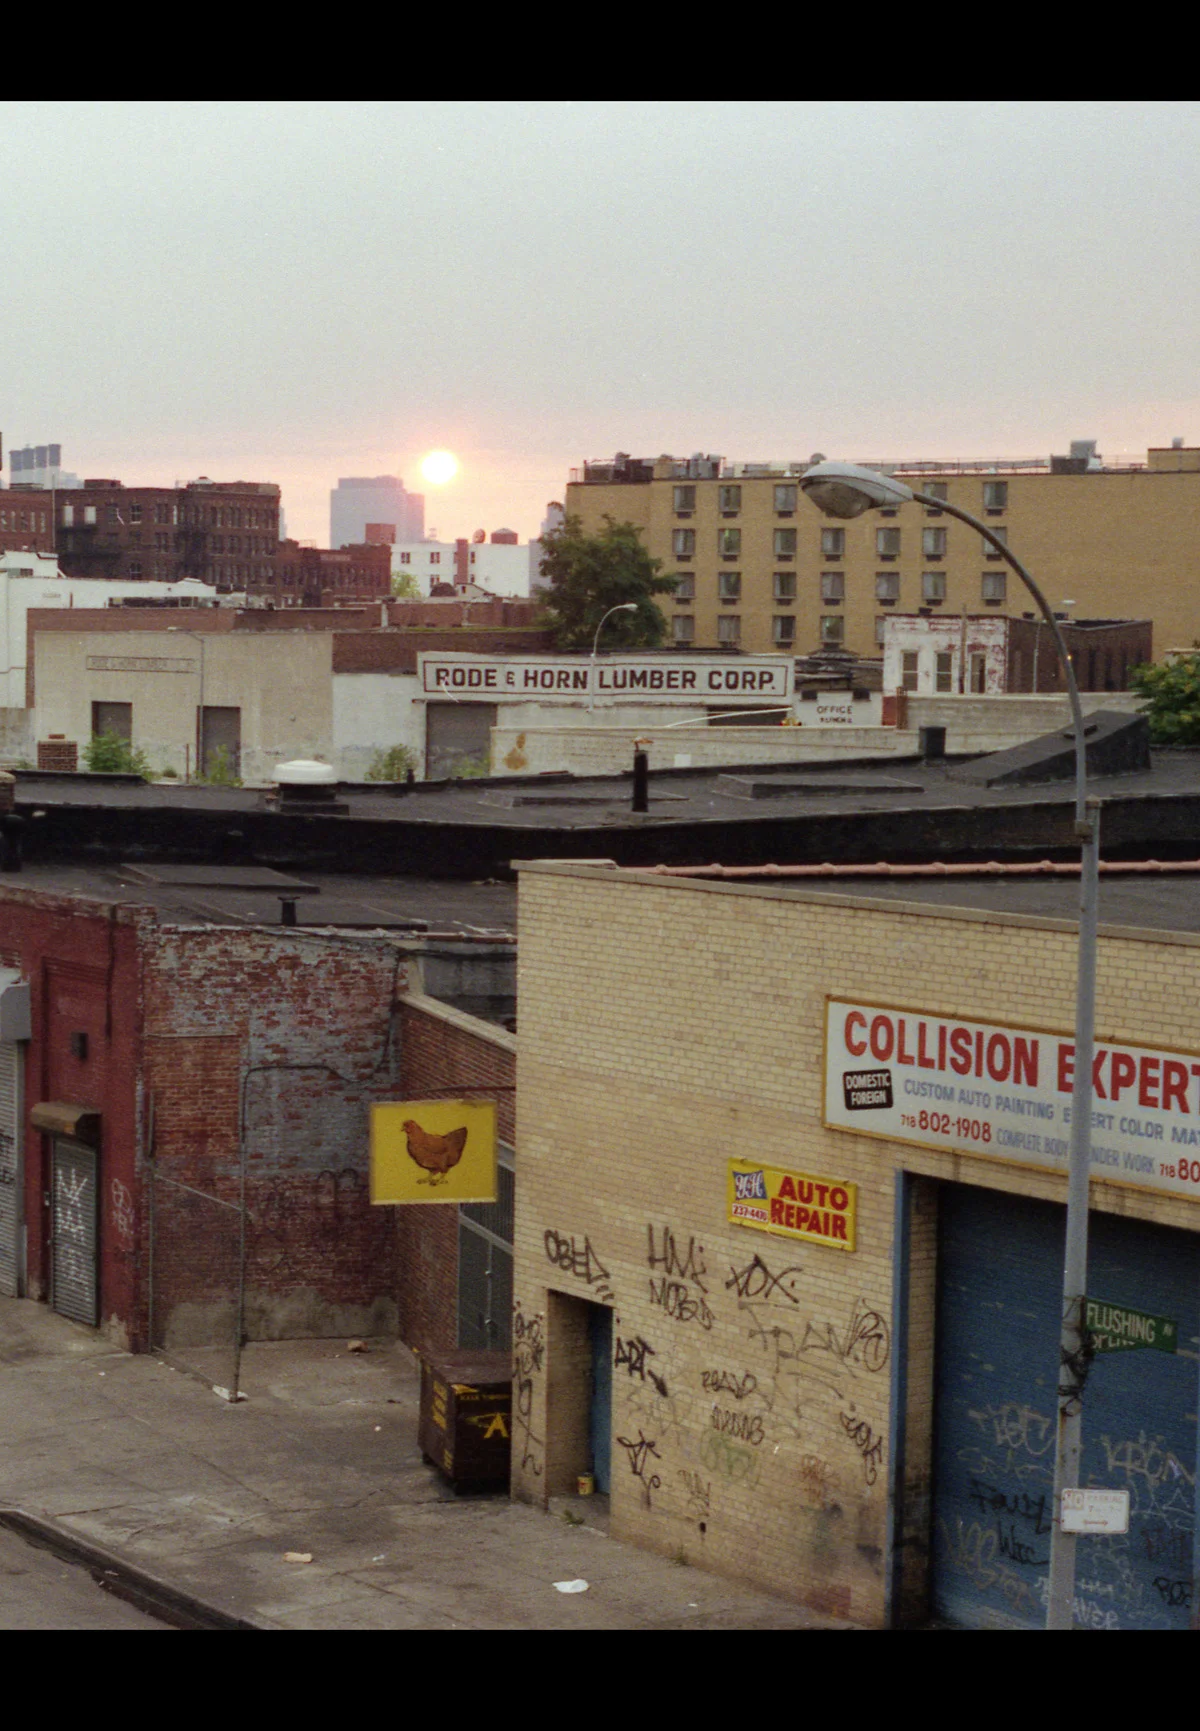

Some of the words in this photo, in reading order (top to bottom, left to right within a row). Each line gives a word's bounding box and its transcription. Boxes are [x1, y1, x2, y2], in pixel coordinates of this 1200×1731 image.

[435, 668, 498, 688] RODE
[523, 668, 588, 690] HORN
[598, 669, 697, 689] LUMBER
[708, 670, 776, 690] CORP.
[816, 705, 853, 714] OFFICE
[844, 1010, 1039, 1088] COLLISION
[845, 1072, 891, 1089] DOMESTIC
[851, 1090, 887, 1106] FOREIGN
[904, 1079, 955, 1101] CUSTOM
[958, 1088, 991, 1109] AUTO
[995, 1095, 1054, 1120] PAINTING
[1120, 1116, 1164, 1140] COLOR
[1171, 1126, 1200, 1146] MA
[901, 1114, 916, 1128] 718
[918, 1110, 992, 1143] 802-1908
[997, 1127, 1041, 1153] COMPLETE
[1123, 1150, 1155, 1175] WORK
[1160, 1163, 1175, 1178] 718
[778, 1175, 849, 1211] AUTO
[770, 1198, 848, 1240] REPAIR
[1086, 1302, 1156, 1343] FLUSHING
